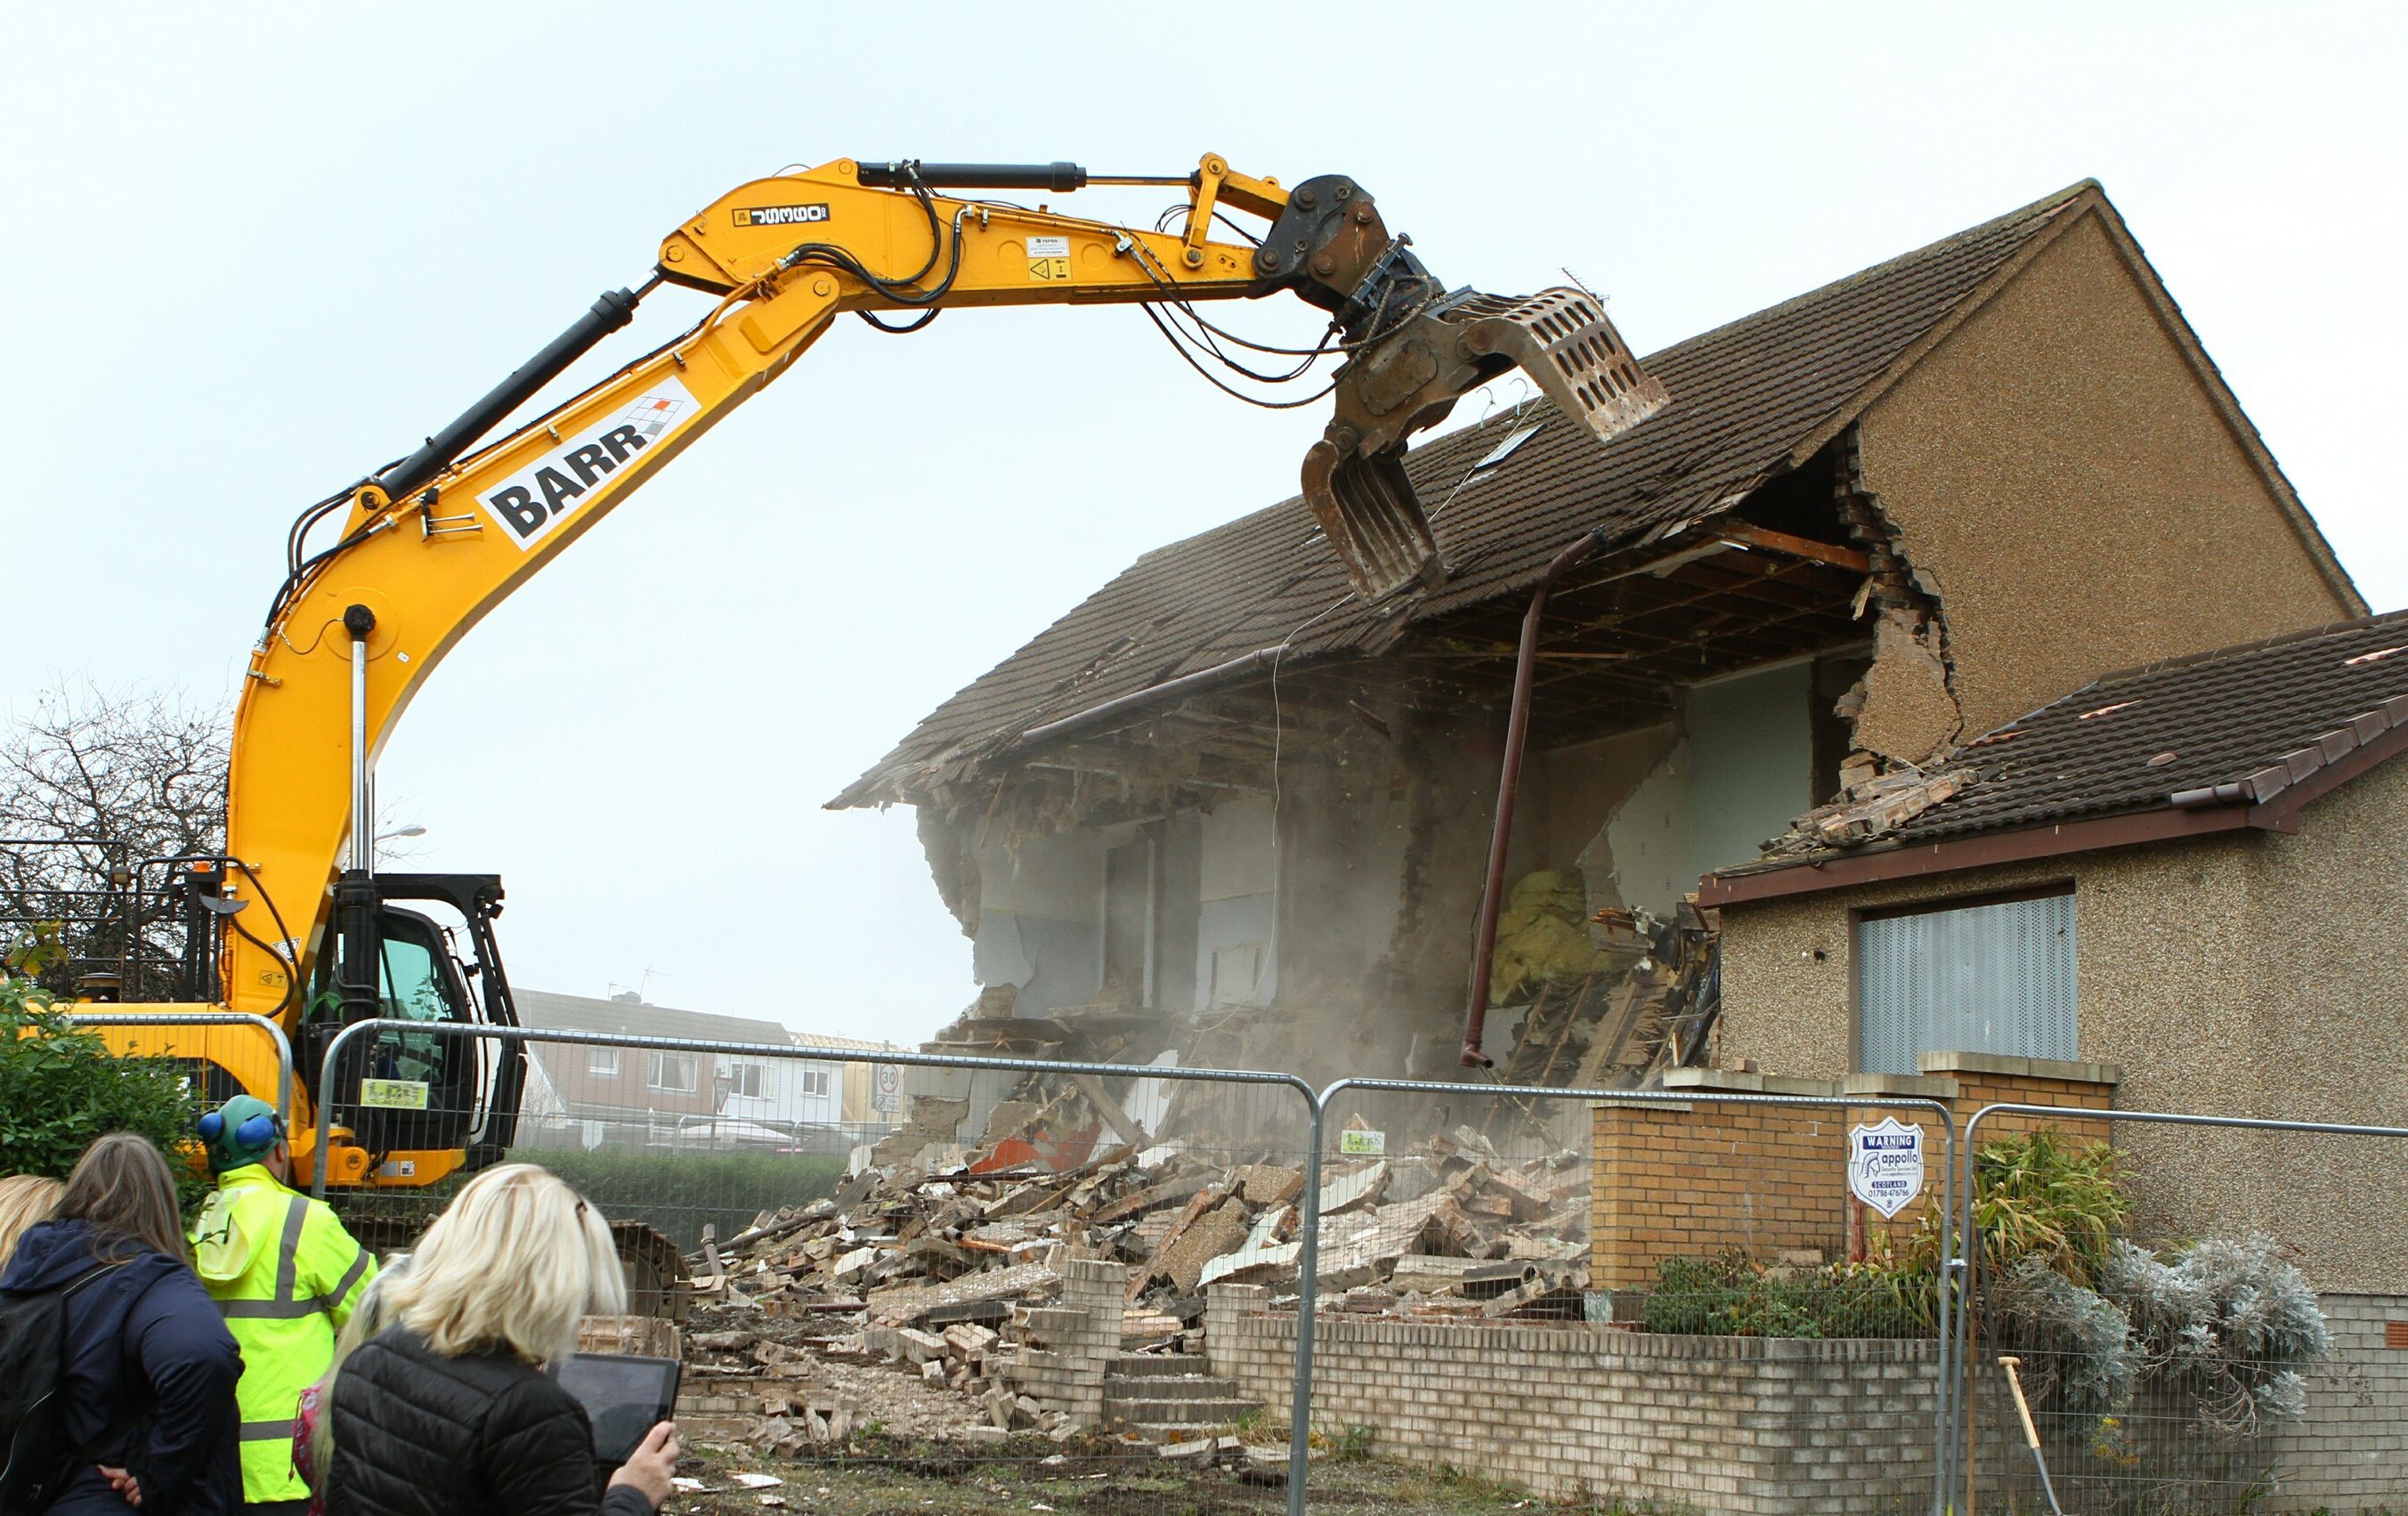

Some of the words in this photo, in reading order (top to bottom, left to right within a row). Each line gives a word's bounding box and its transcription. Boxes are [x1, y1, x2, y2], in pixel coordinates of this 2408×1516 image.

[751, 206, 821, 224] JS360
[489, 424, 648, 539] BARR
[882, 1071, 896, 1083] 30
[1868, 1136, 1912, 1146] WARNING
[1882, 1150, 1917, 1166] appollo
